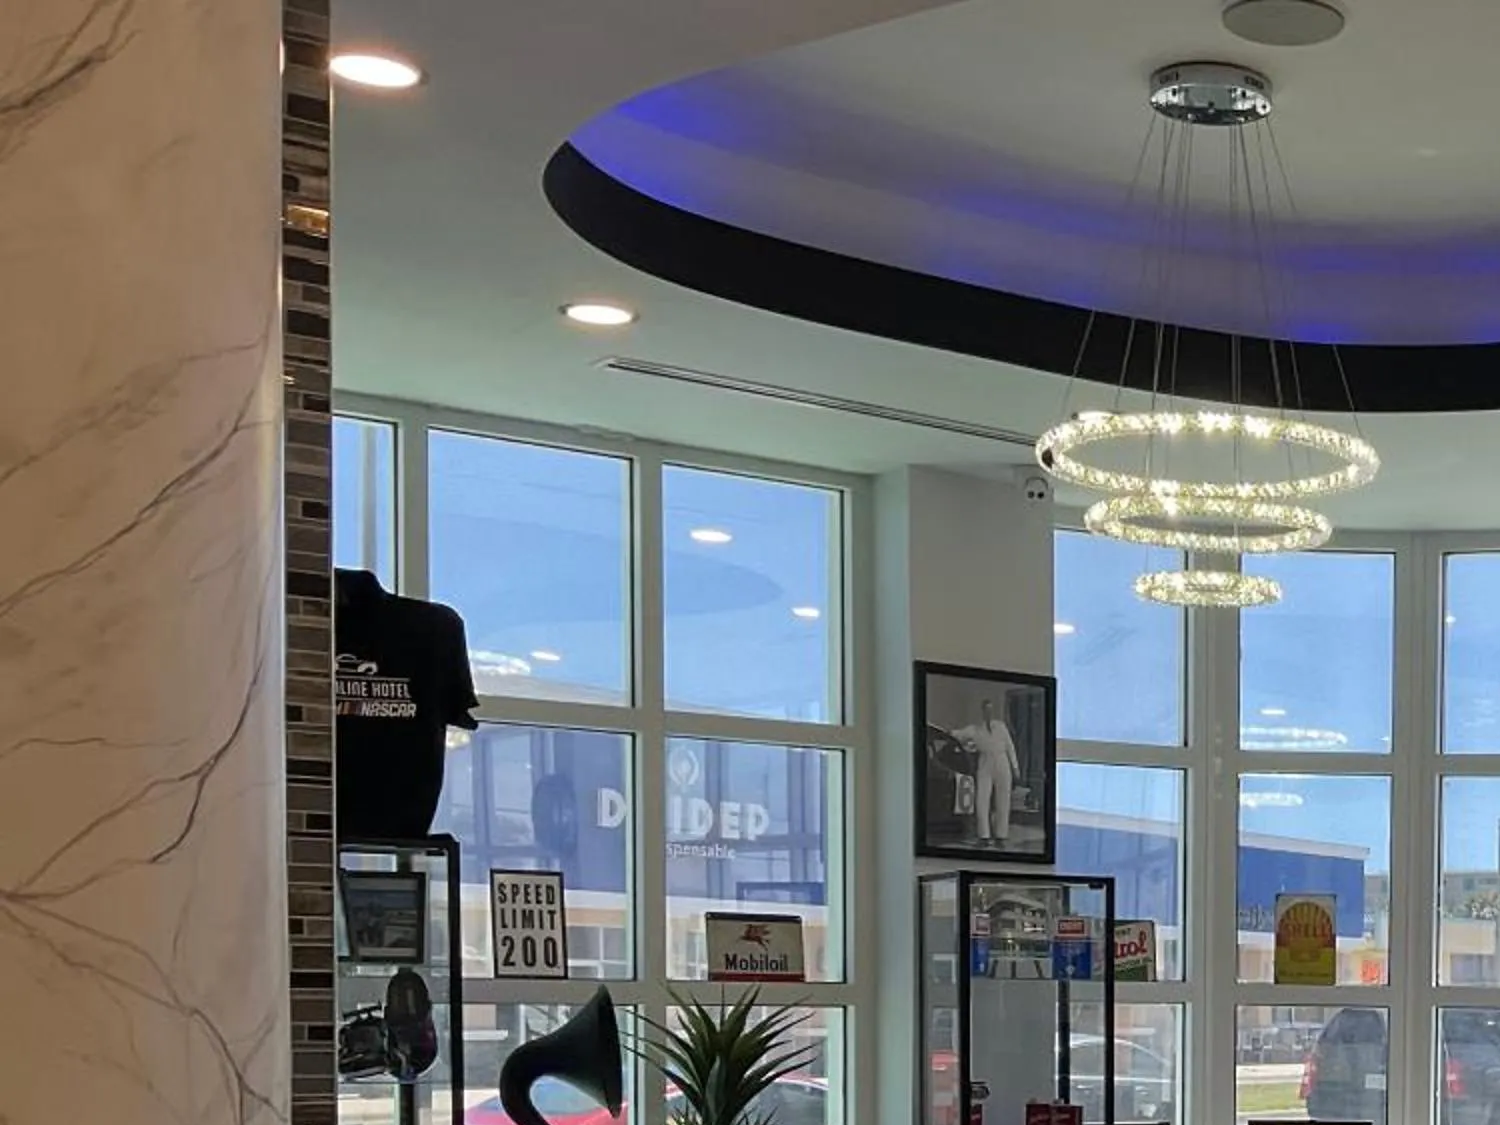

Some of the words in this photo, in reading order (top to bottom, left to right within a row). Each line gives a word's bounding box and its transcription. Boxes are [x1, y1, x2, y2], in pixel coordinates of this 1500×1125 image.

[336, 681, 368, 697] LINE
[372, 683, 411, 698] HOTEL
[361, 702, 417, 718] NASCAR
[597, 787, 770, 841] DIDEP
[498, 882, 555, 905] SPEED
[501, 908, 556, 930] LIMIT
[502, 935, 558, 968] 200
[724, 952, 788, 971] Mobiloil
